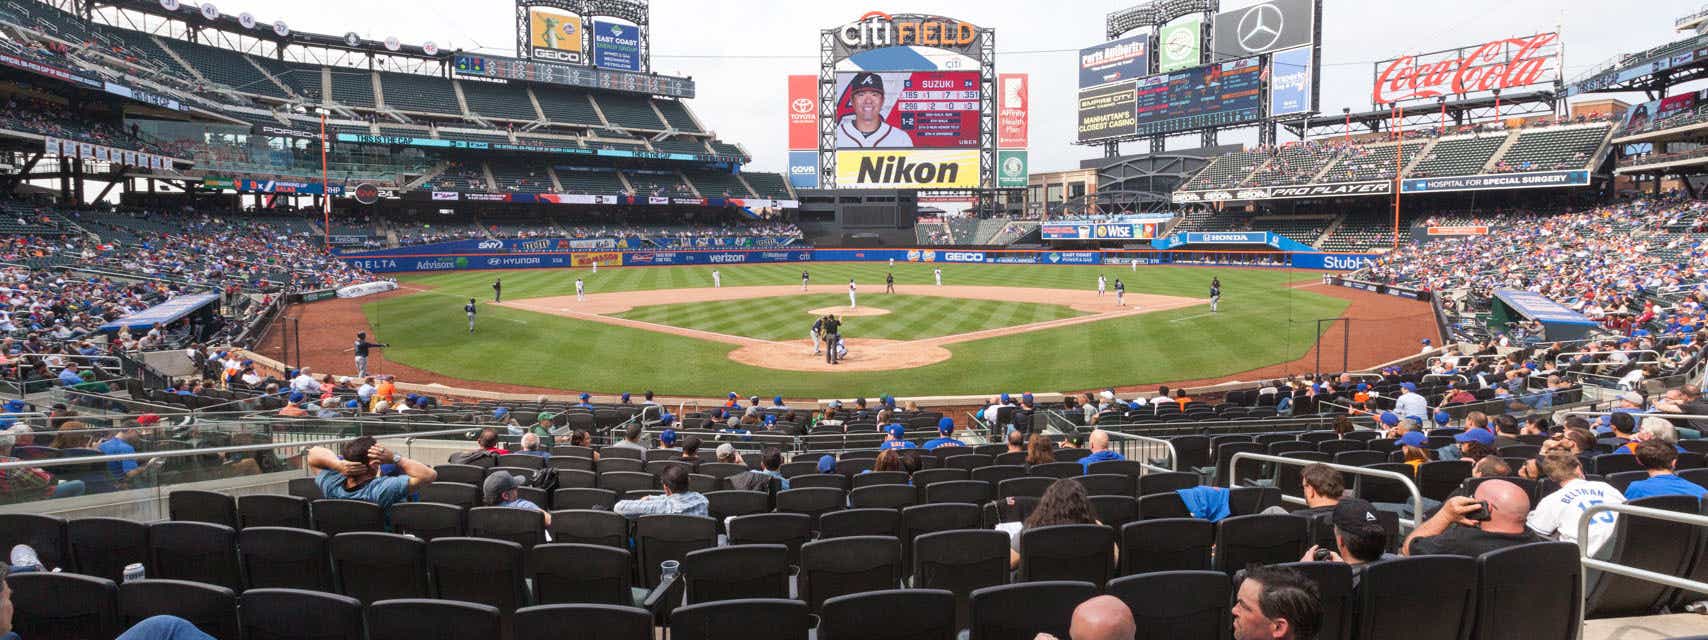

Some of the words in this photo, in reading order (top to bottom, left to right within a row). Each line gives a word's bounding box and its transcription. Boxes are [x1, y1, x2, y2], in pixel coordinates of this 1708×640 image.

[206, 7, 215, 15] 41
[840, 17, 890, 45] citi
[898, 21, 975, 45] FIELD
[596, 35, 614, 43] EAST
[615, 38, 637, 46] COAST
[534, 49, 579, 62] GEICO
[922, 80, 954, 88] SUZUKI
[1081, 97, 1112, 107] EMPIRE
[1113, 93, 1133, 102] CITY
[902, 118, 914, 126] 1-2
[1084, 111, 1130, 124] MANHATTAN'S
[1079, 121, 1107, 133] CLOSEST
[1109, 118, 1135, 128] CASINO
[856, 155, 959, 184] Nikon
[1427, 180, 1465, 189] HOSPITAL
[1465, 179, 1482, 187] FOR
[1483, 176, 1521, 186] SPECIAL
[1522, 174, 1567, 184] SURGERY
[1271, 187, 1308, 198] PRO
[1308, 183, 1390, 196] PLAYER
[1107, 225, 1131, 238] WISE
[503, 257, 540, 265] HYUNDAI
[709, 253, 745, 262] verizon
[945, 252, 983, 261] GEICO
[355, 259, 396, 270] DELTA
[416, 259, 454, 270] Advisors
[1561, 489, 1604, 505] BELTRAN
